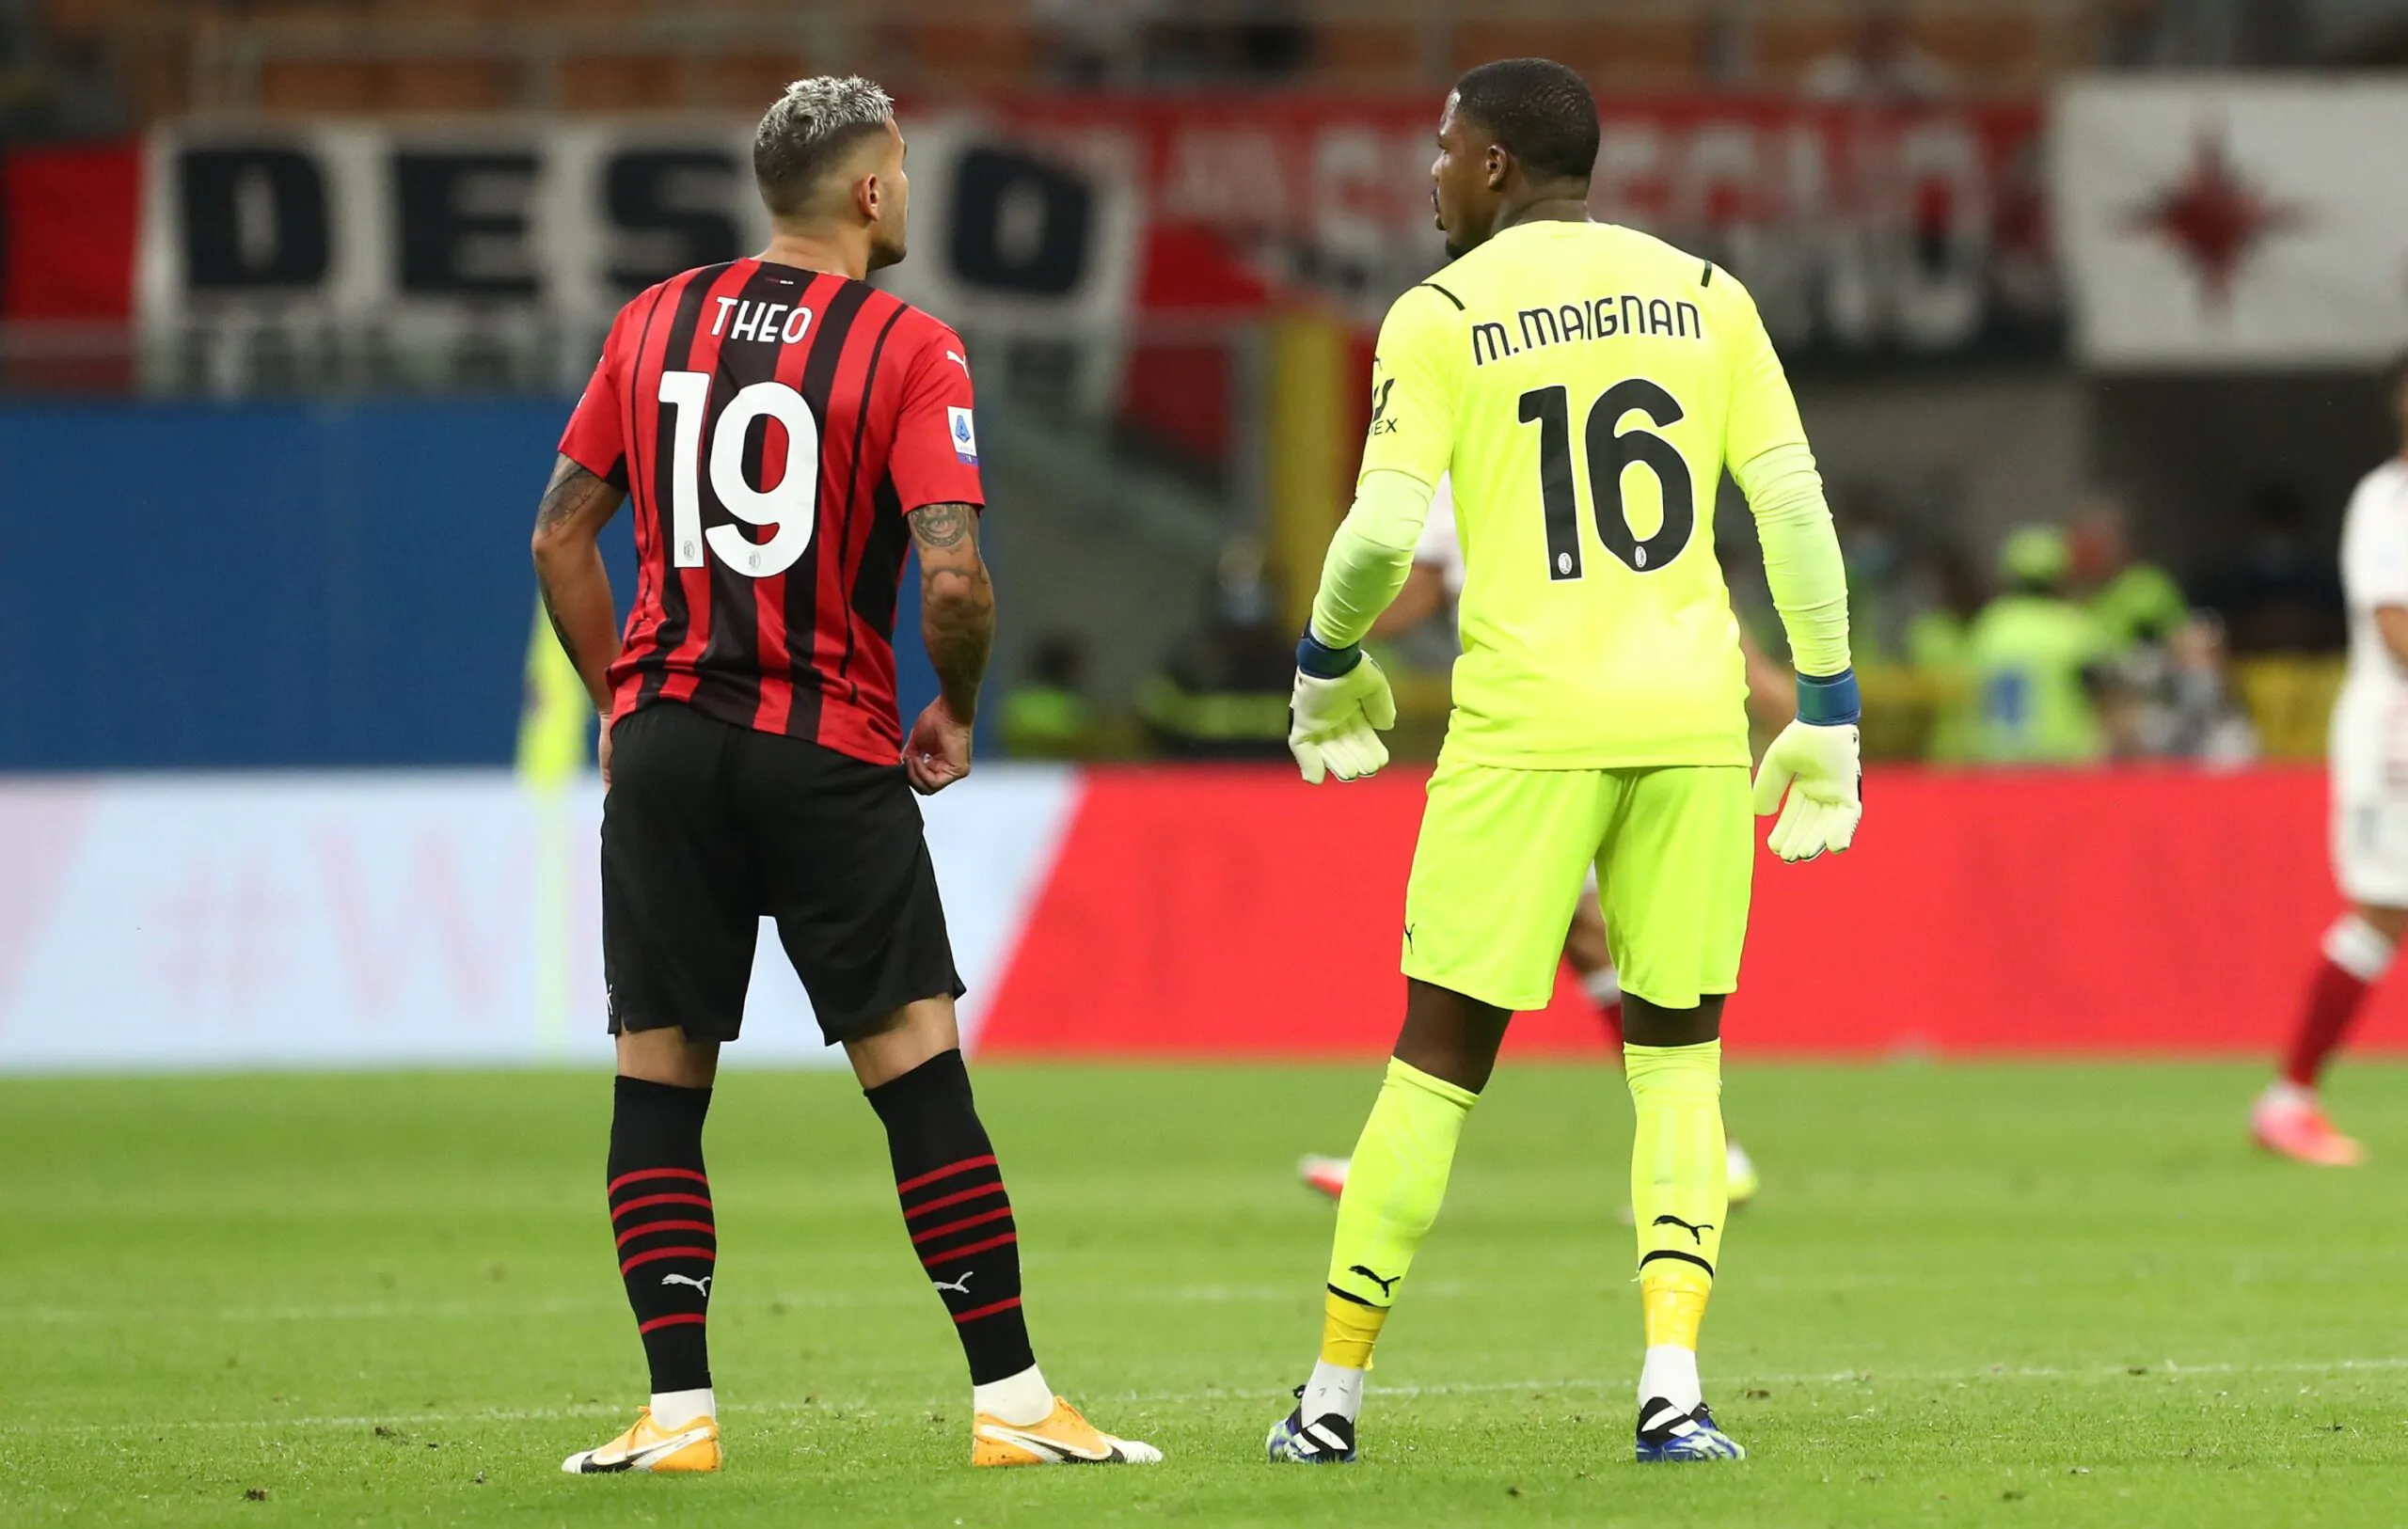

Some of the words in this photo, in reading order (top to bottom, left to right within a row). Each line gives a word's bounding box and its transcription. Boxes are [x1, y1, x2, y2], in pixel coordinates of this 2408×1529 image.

[179, 146, 1091, 294] DESO
[712, 296, 813, 344] THEO
[1472, 295, 1701, 366] M.MAIGNAN
[658, 371, 818, 577] 19
[1370, 418, 1398, 436] EX
[1518, 378, 1693, 580] 16
